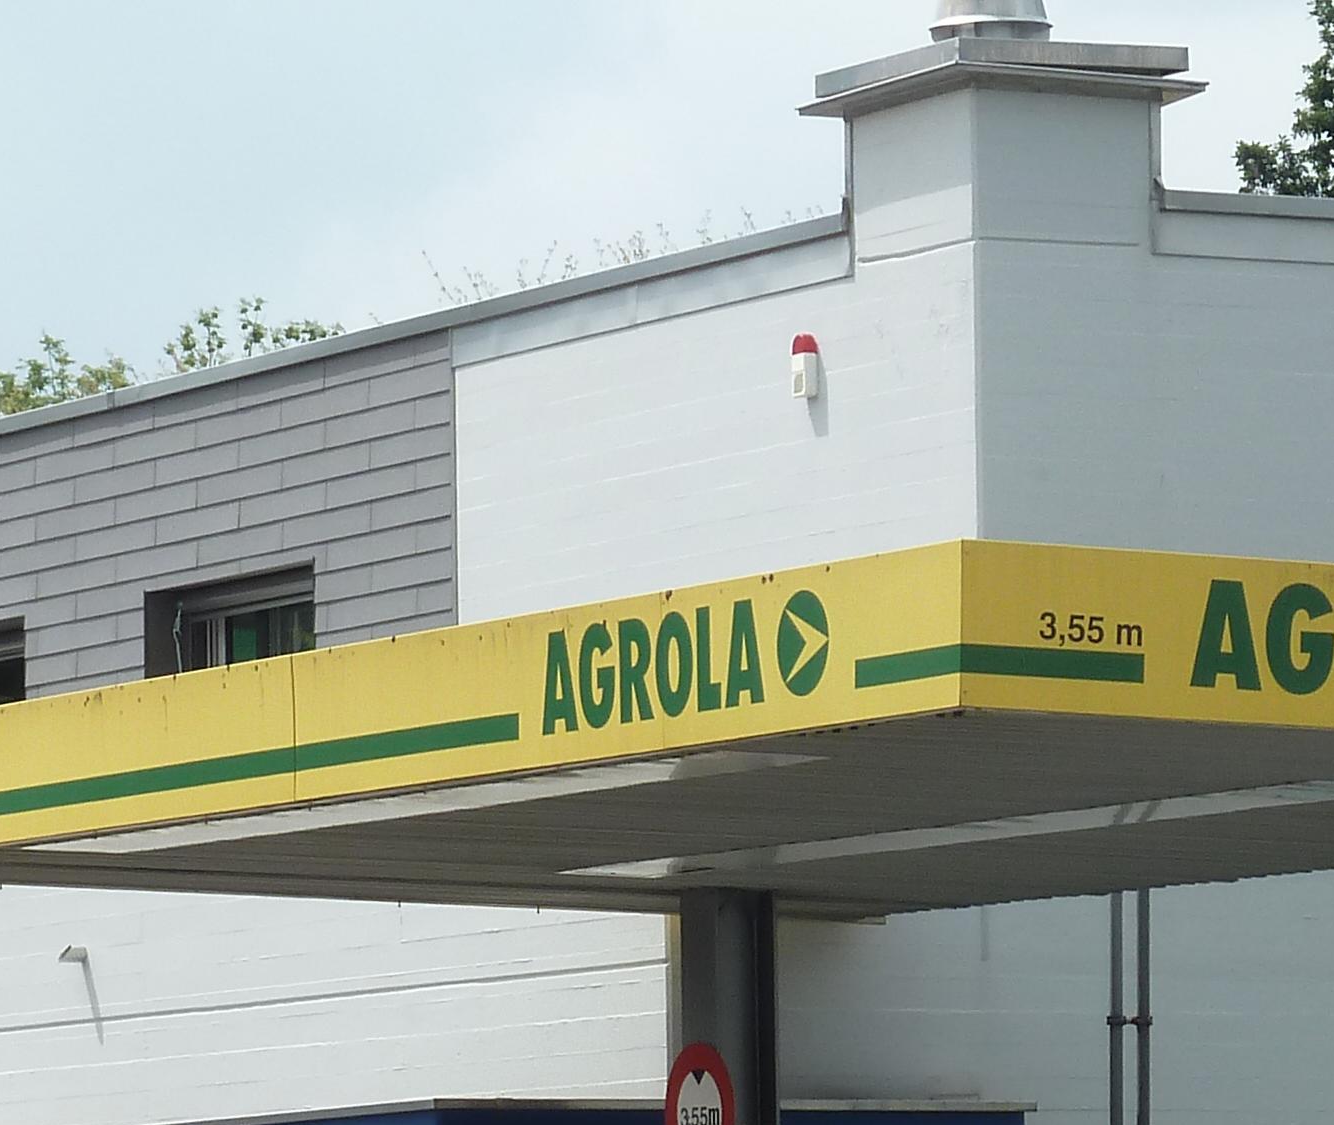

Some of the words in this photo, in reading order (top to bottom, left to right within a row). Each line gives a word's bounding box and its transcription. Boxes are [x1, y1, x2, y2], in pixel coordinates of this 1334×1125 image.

[542, 598, 765, 736] AGROLA
[1038, 611, 1105, 647] 3,55
[1116, 623, 1143, 647] m
